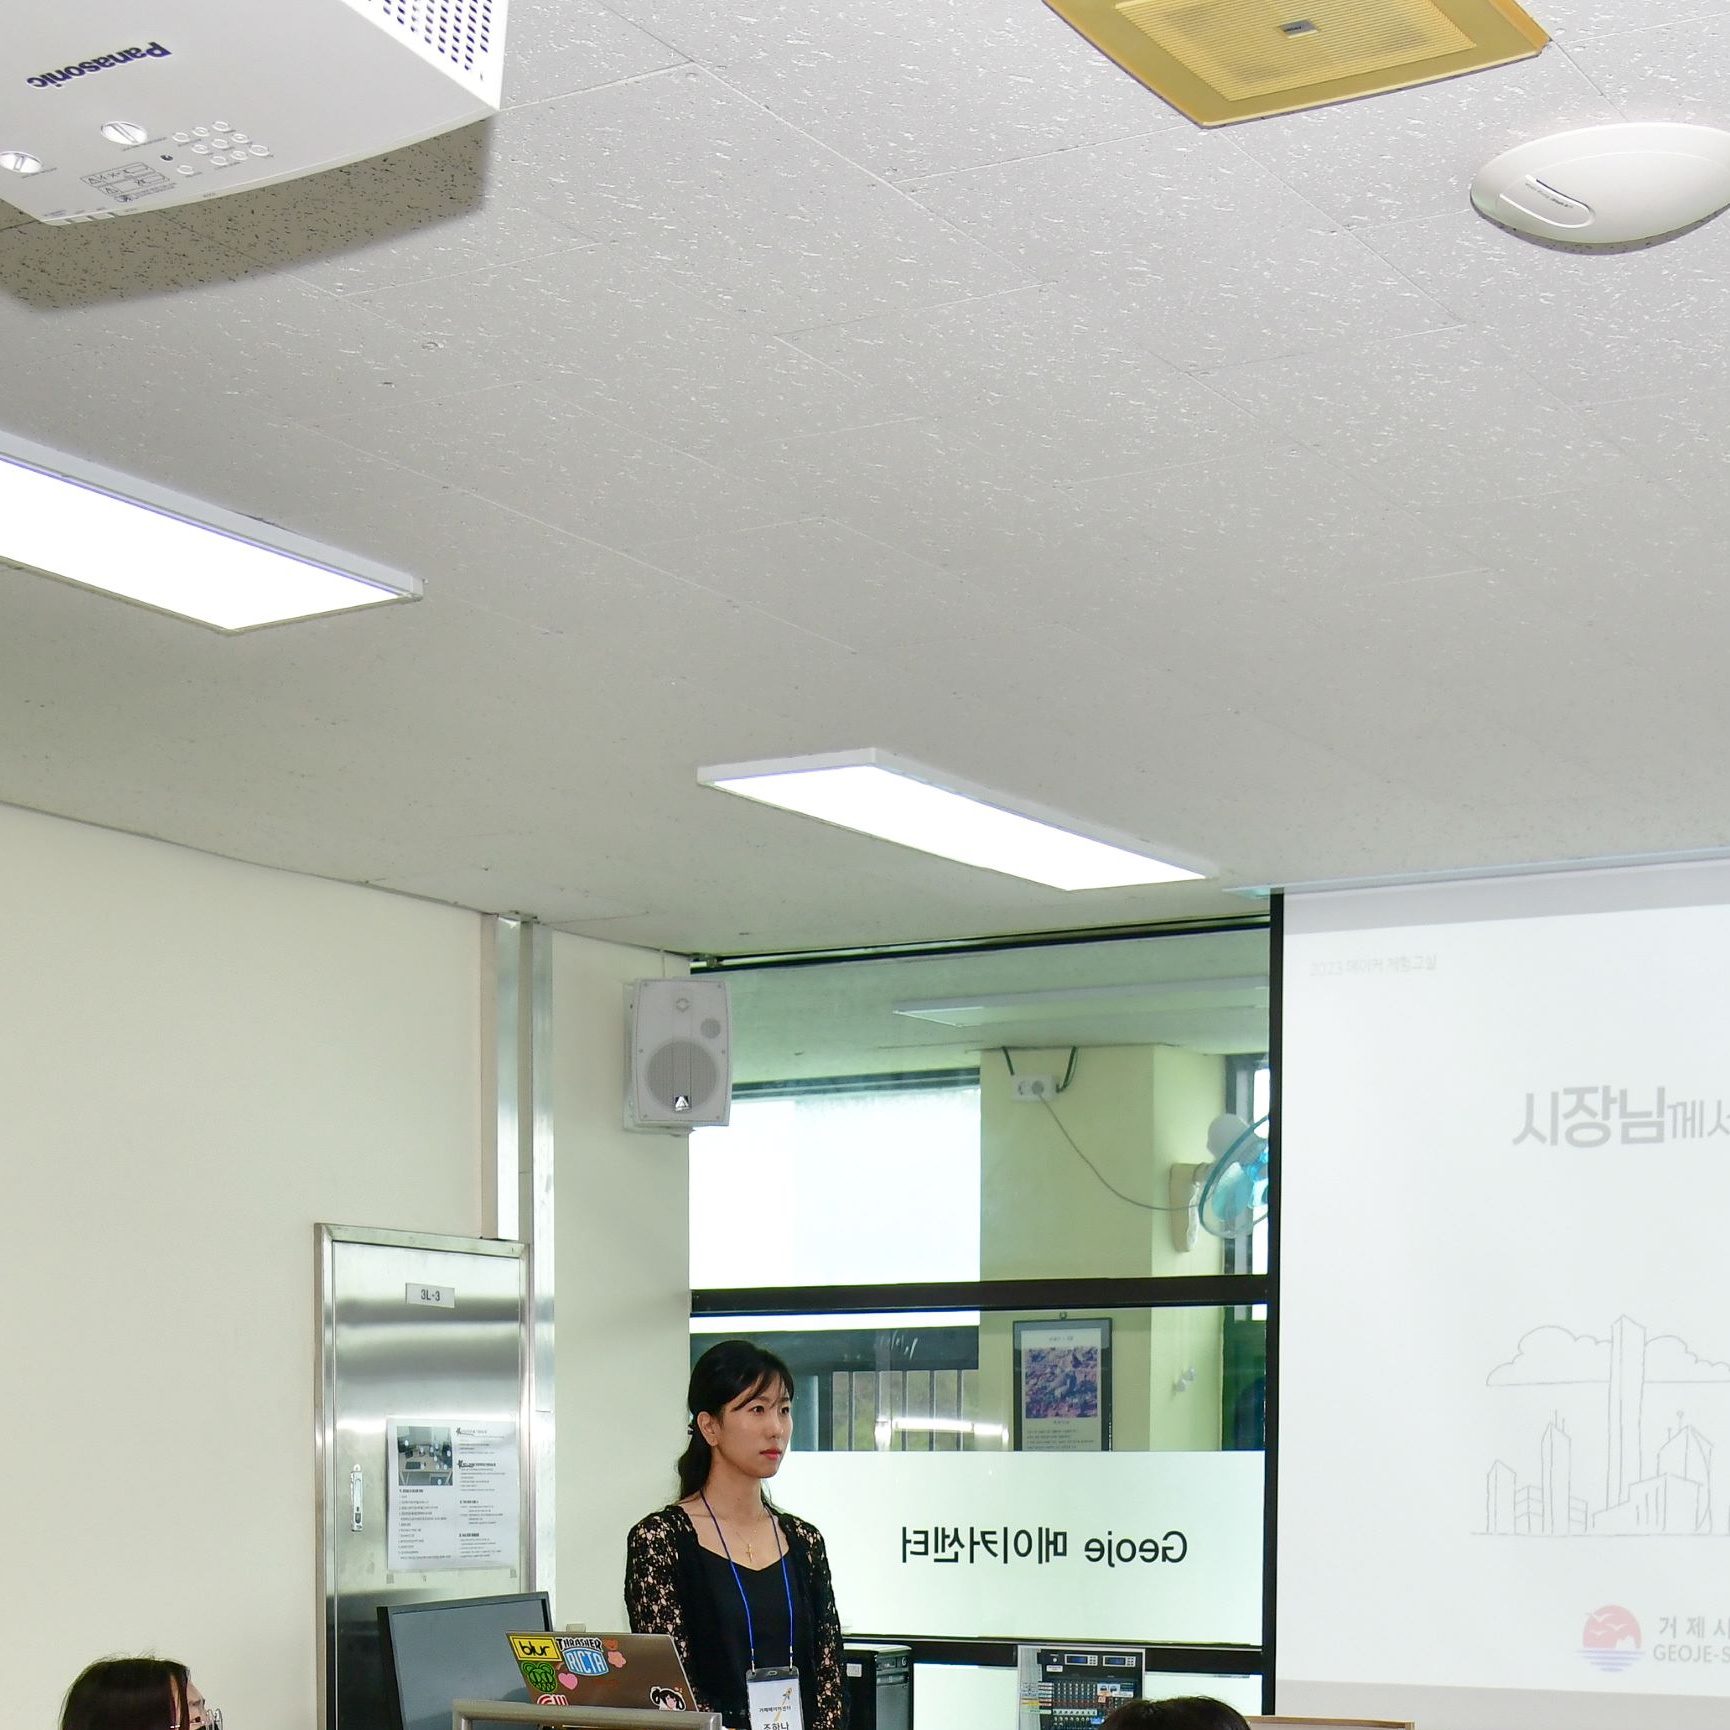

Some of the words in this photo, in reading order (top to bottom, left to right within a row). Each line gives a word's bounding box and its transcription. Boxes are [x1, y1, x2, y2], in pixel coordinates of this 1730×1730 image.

[26, 41, 172, 88] Panasonic
[421, 1288, 440, 1301] 3L-3
[518, 1641, 551, 1657] blur
[556, 1637, 603, 1651] THRASHER
[569, 1650, 607, 1673] RICTA
